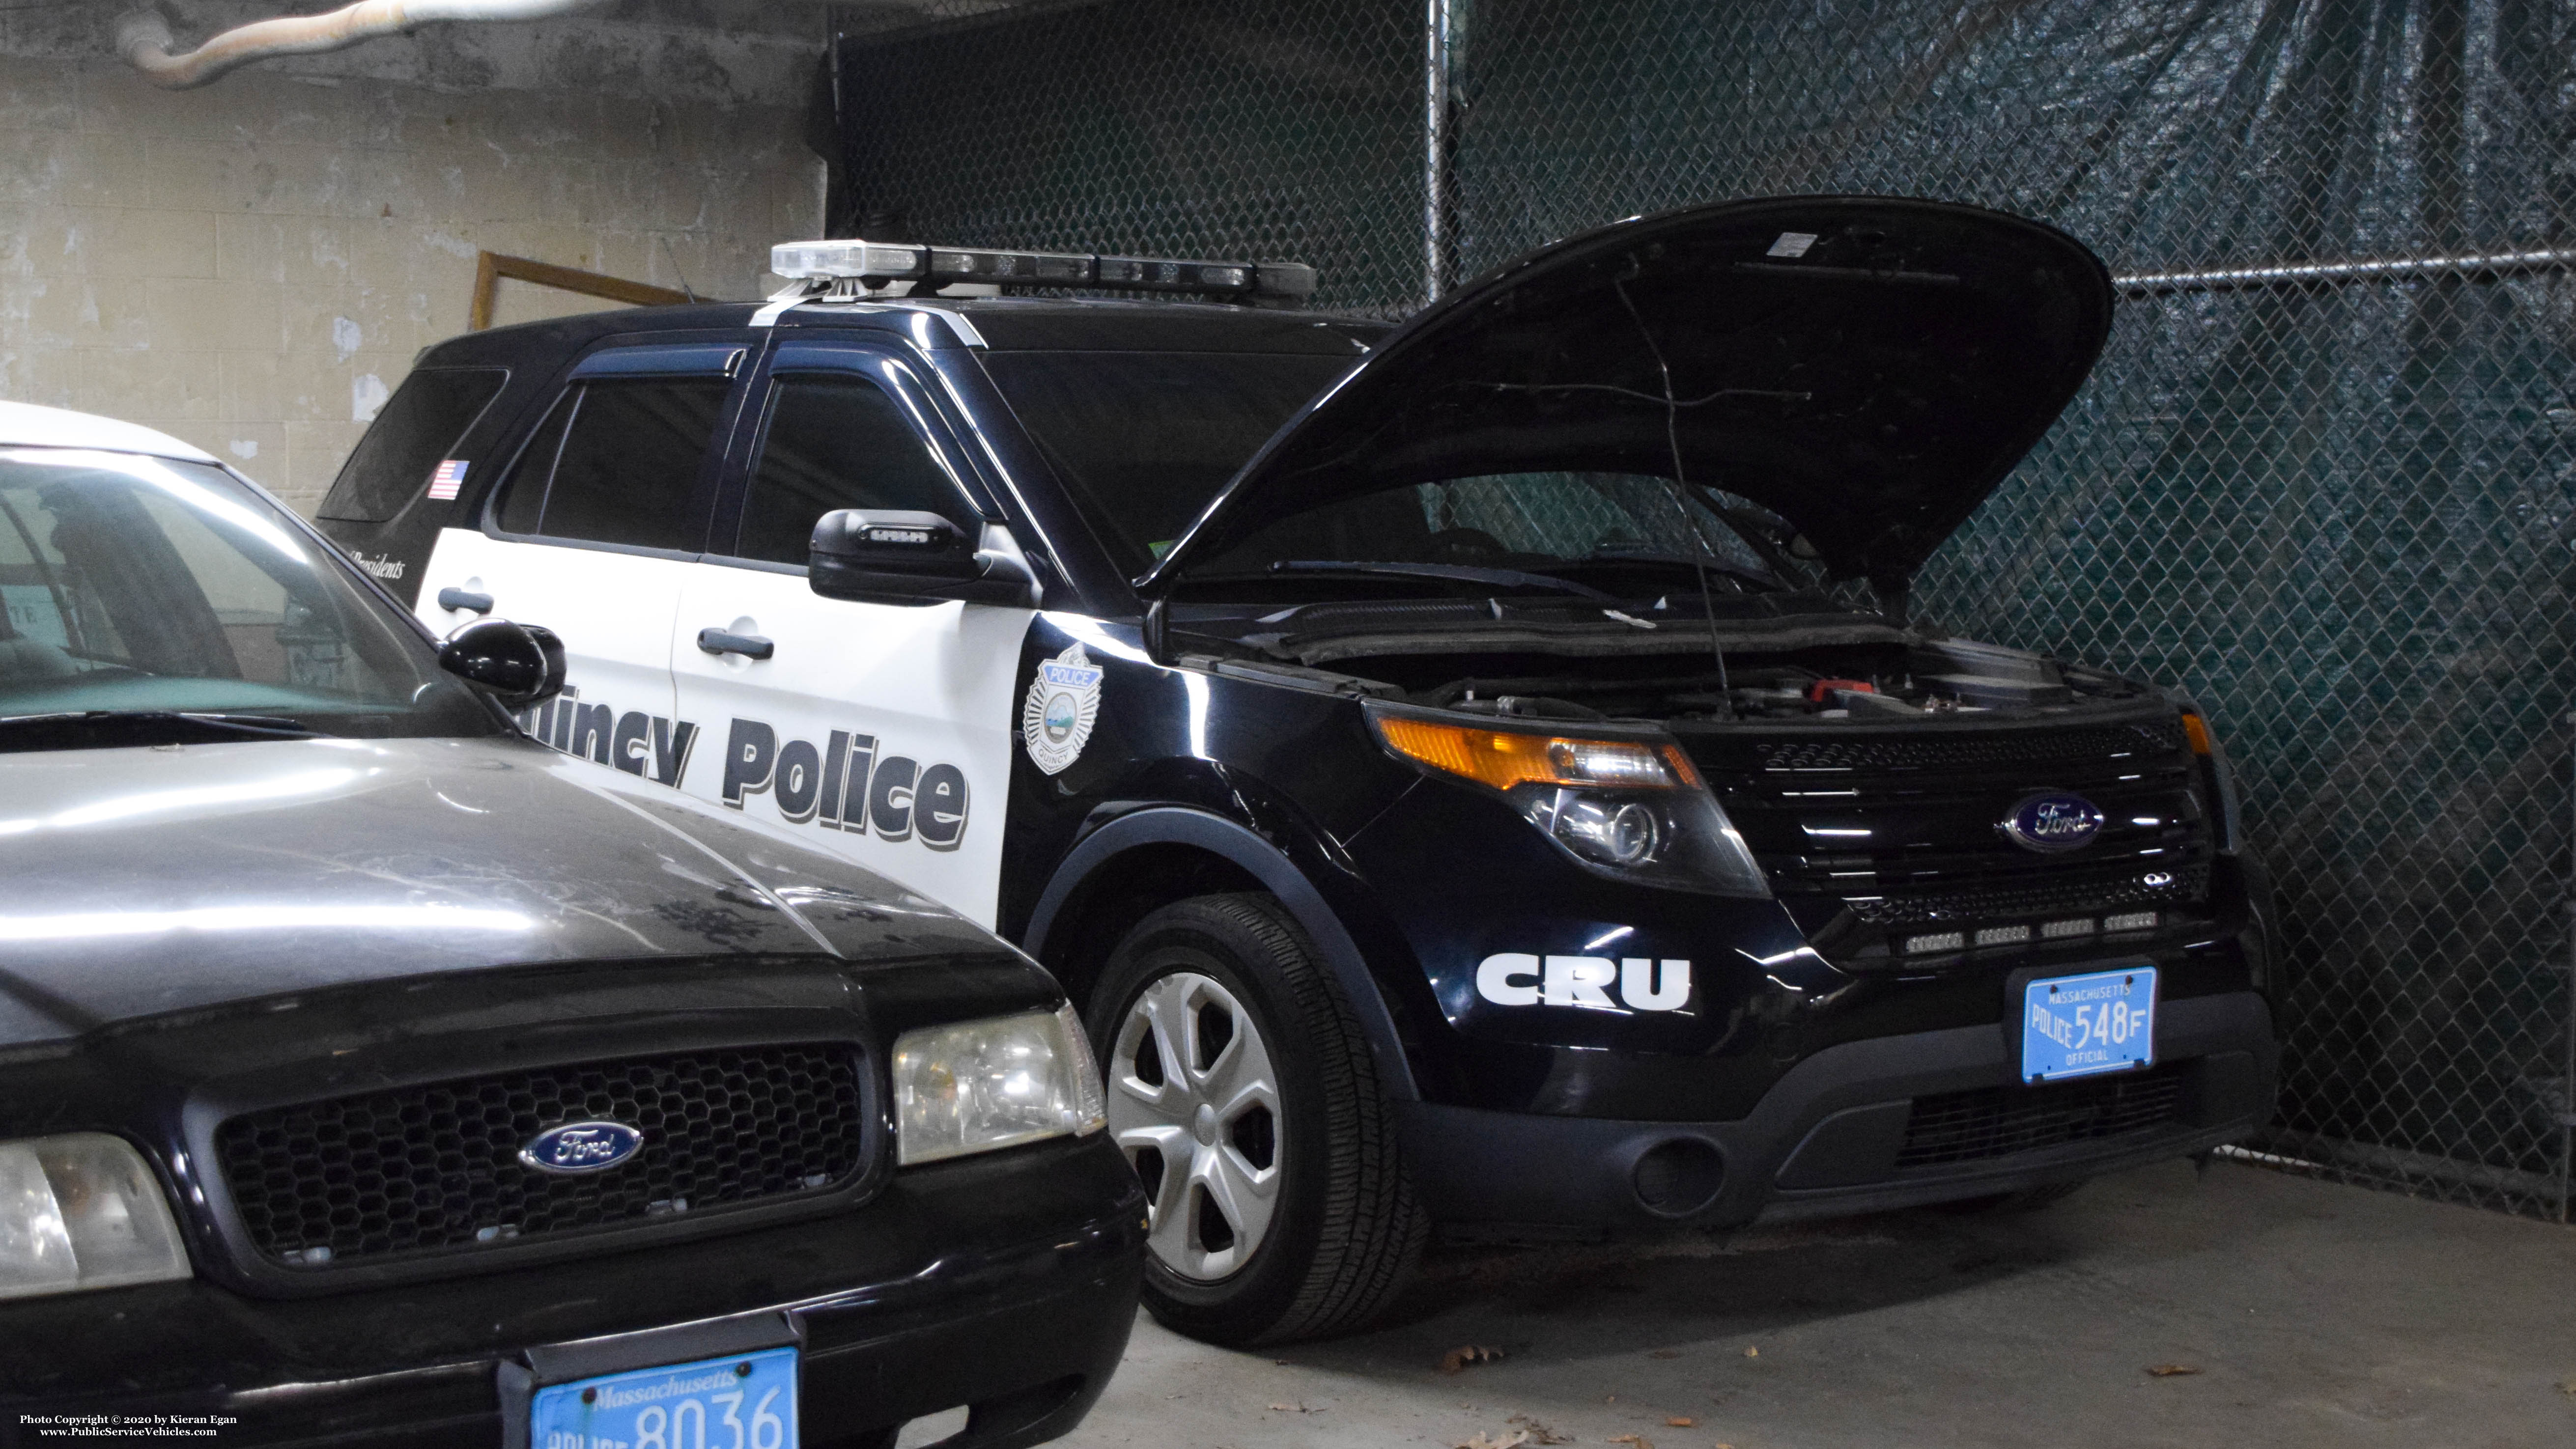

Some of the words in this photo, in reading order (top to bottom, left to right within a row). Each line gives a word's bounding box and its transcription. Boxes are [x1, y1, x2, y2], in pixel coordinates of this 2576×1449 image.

[1050, 667, 1091, 685] POLICE
[1038, 748, 1069, 764] QUINCY
[722, 714, 971, 852] Police
[2035, 803, 2092, 835] Ford
[1476, 952, 1690, 1011] CRU
[2049, 983, 2131, 1004] MASSACHUSETTS
[2032, 1003, 2072, 1049] POLICE
[2074, 1001, 2147, 1050] 548F
[2066, 1049, 2109, 1066] OFFICIAL
[555, 1129, 616, 1162] Ford
[593, 1371, 737, 1411] Massachusetts
[636, 1385, 783, 1449] 8036
